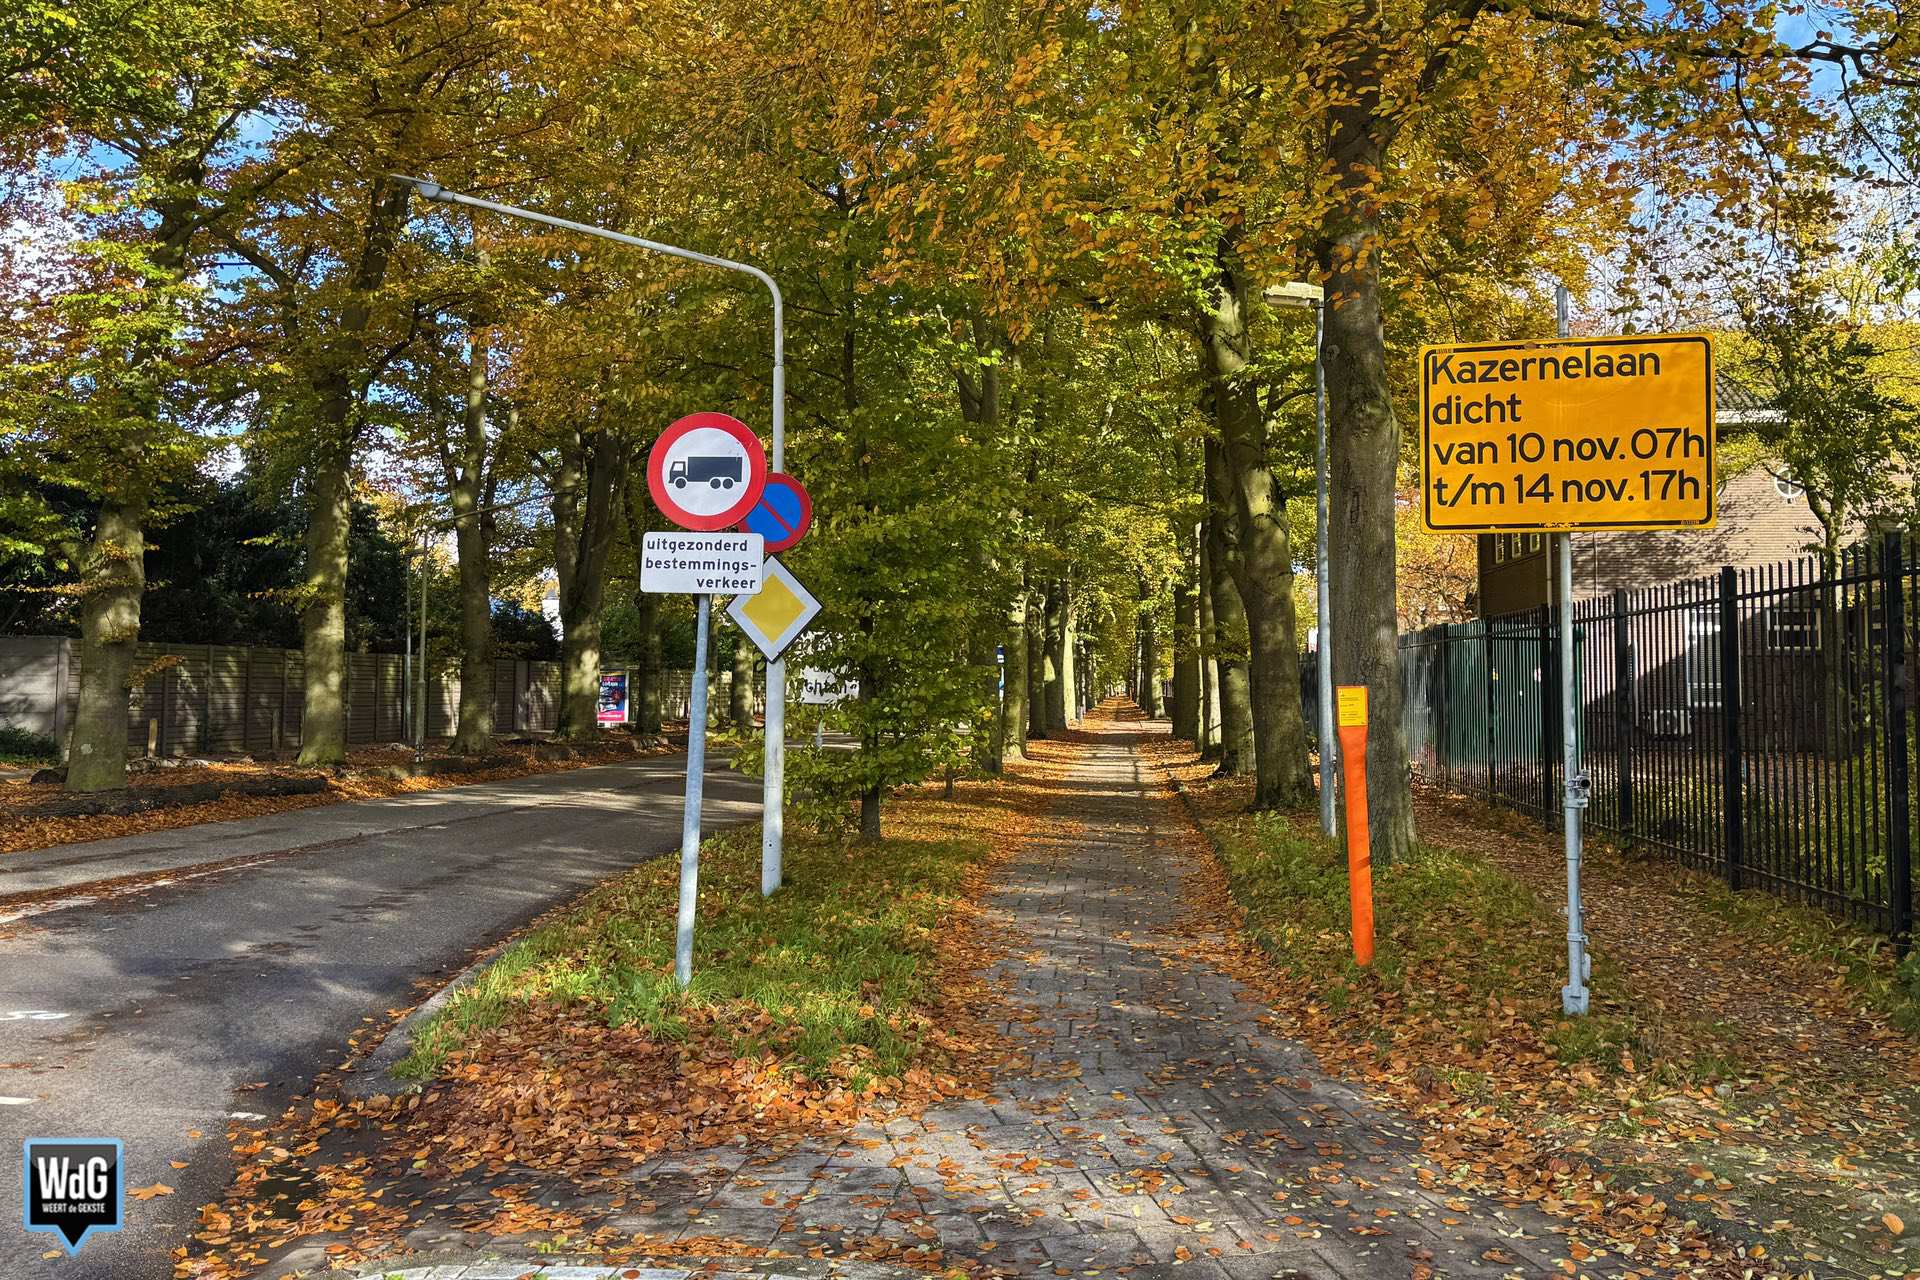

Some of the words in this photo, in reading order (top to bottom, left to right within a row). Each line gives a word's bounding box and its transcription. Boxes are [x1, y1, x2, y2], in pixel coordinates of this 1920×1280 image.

[1432, 348, 1660, 384] Kazernelaan
[1432, 393, 1521, 425] dicht
[1433, 440, 1498, 465] van
[1507, 432, 1545, 463] 10
[1553, 437, 1626, 462] nov.
[1631, 427, 1704, 459] 07h
[1433, 473, 1505, 507] t/m
[1514, 473, 1554, 504] 14
[1562, 478, 1634, 502] nov.
[1640, 469, 1700, 500] 17h
[647, 538, 748, 553] uitgezonderd
[645, 557, 757, 574] bestemmings-
[696, 576, 756, 589] verkeer
